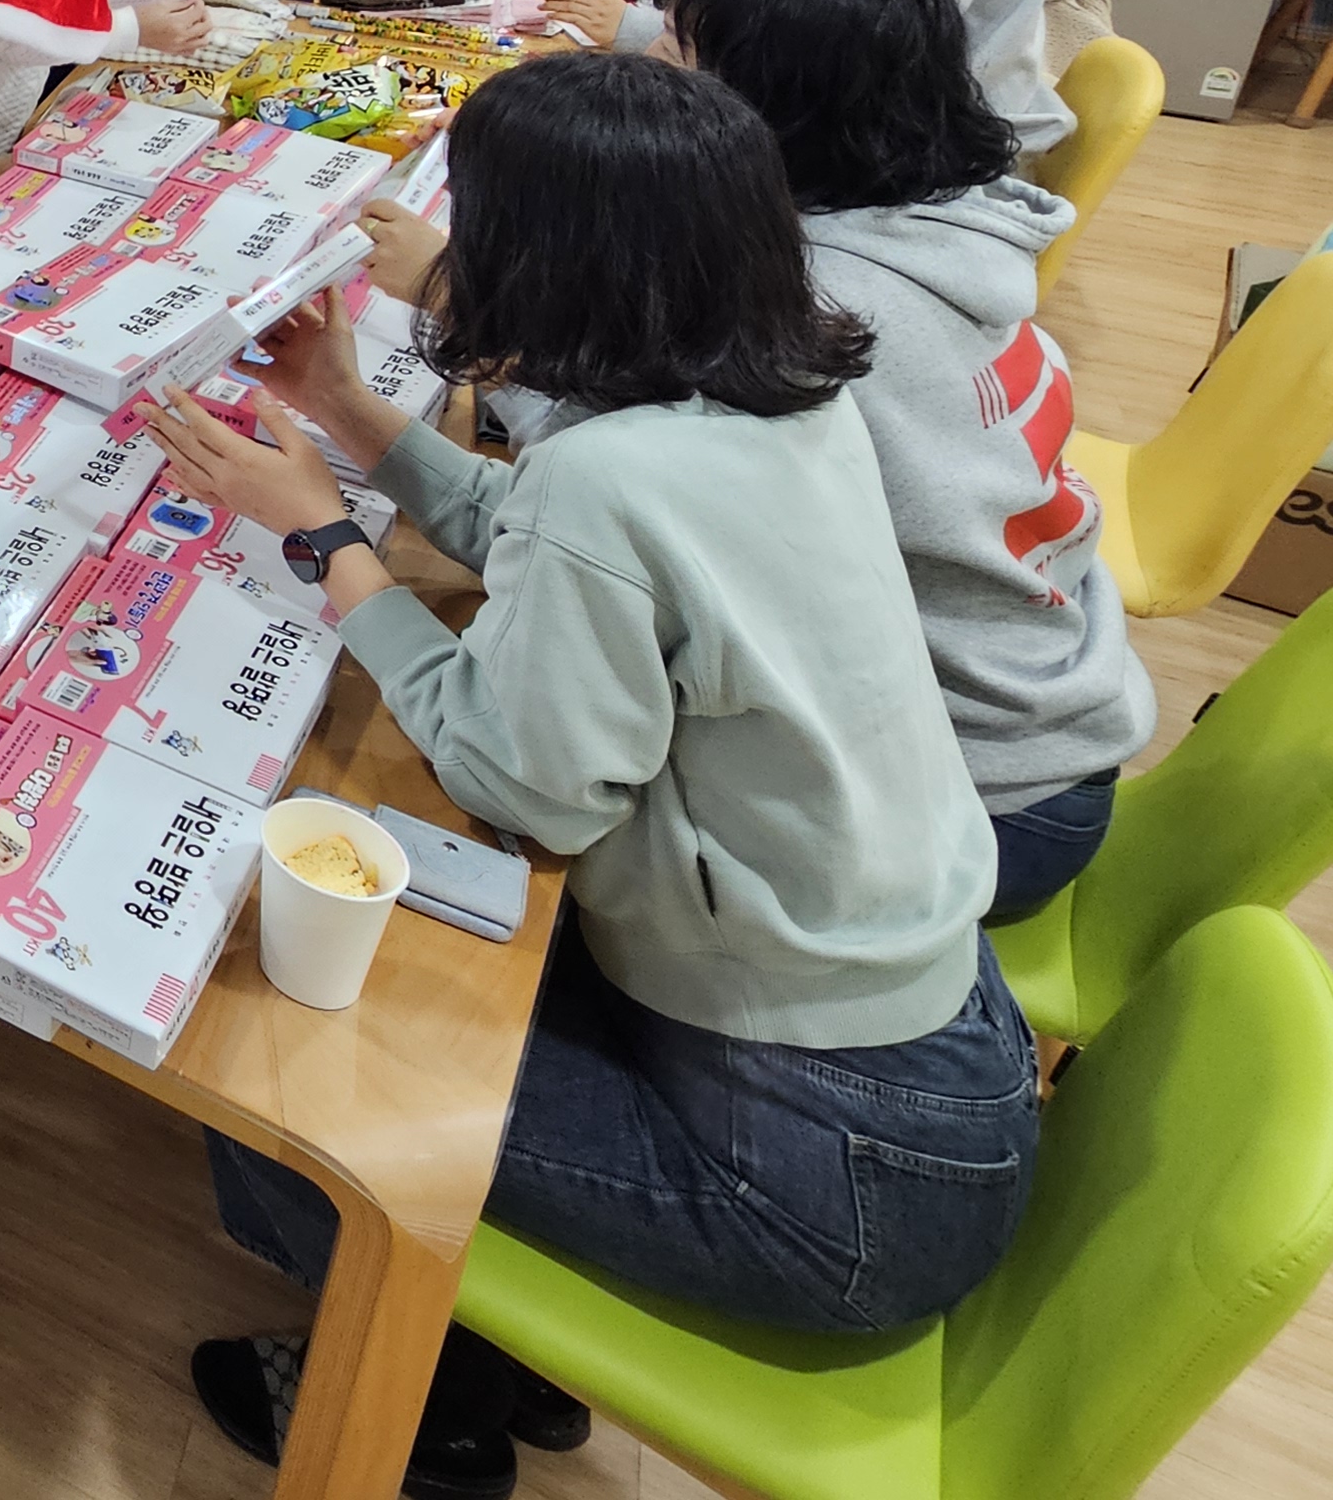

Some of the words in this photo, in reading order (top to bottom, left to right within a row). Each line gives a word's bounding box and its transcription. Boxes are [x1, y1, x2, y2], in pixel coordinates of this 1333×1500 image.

[118, 307, 169, 339] 발명왕
[154, 284, 209, 314] 내일은
[79, 446, 126, 491] 발명왕
[251, 620, 310, 670] 내일은
[221, 666, 279, 723] 발명왕
[160, 796, 226, 859] 내일은
[0, 889, 71, 945] 40
[122, 856, 192, 931] 발명왕
[21, 936, 41, 957] KIT
